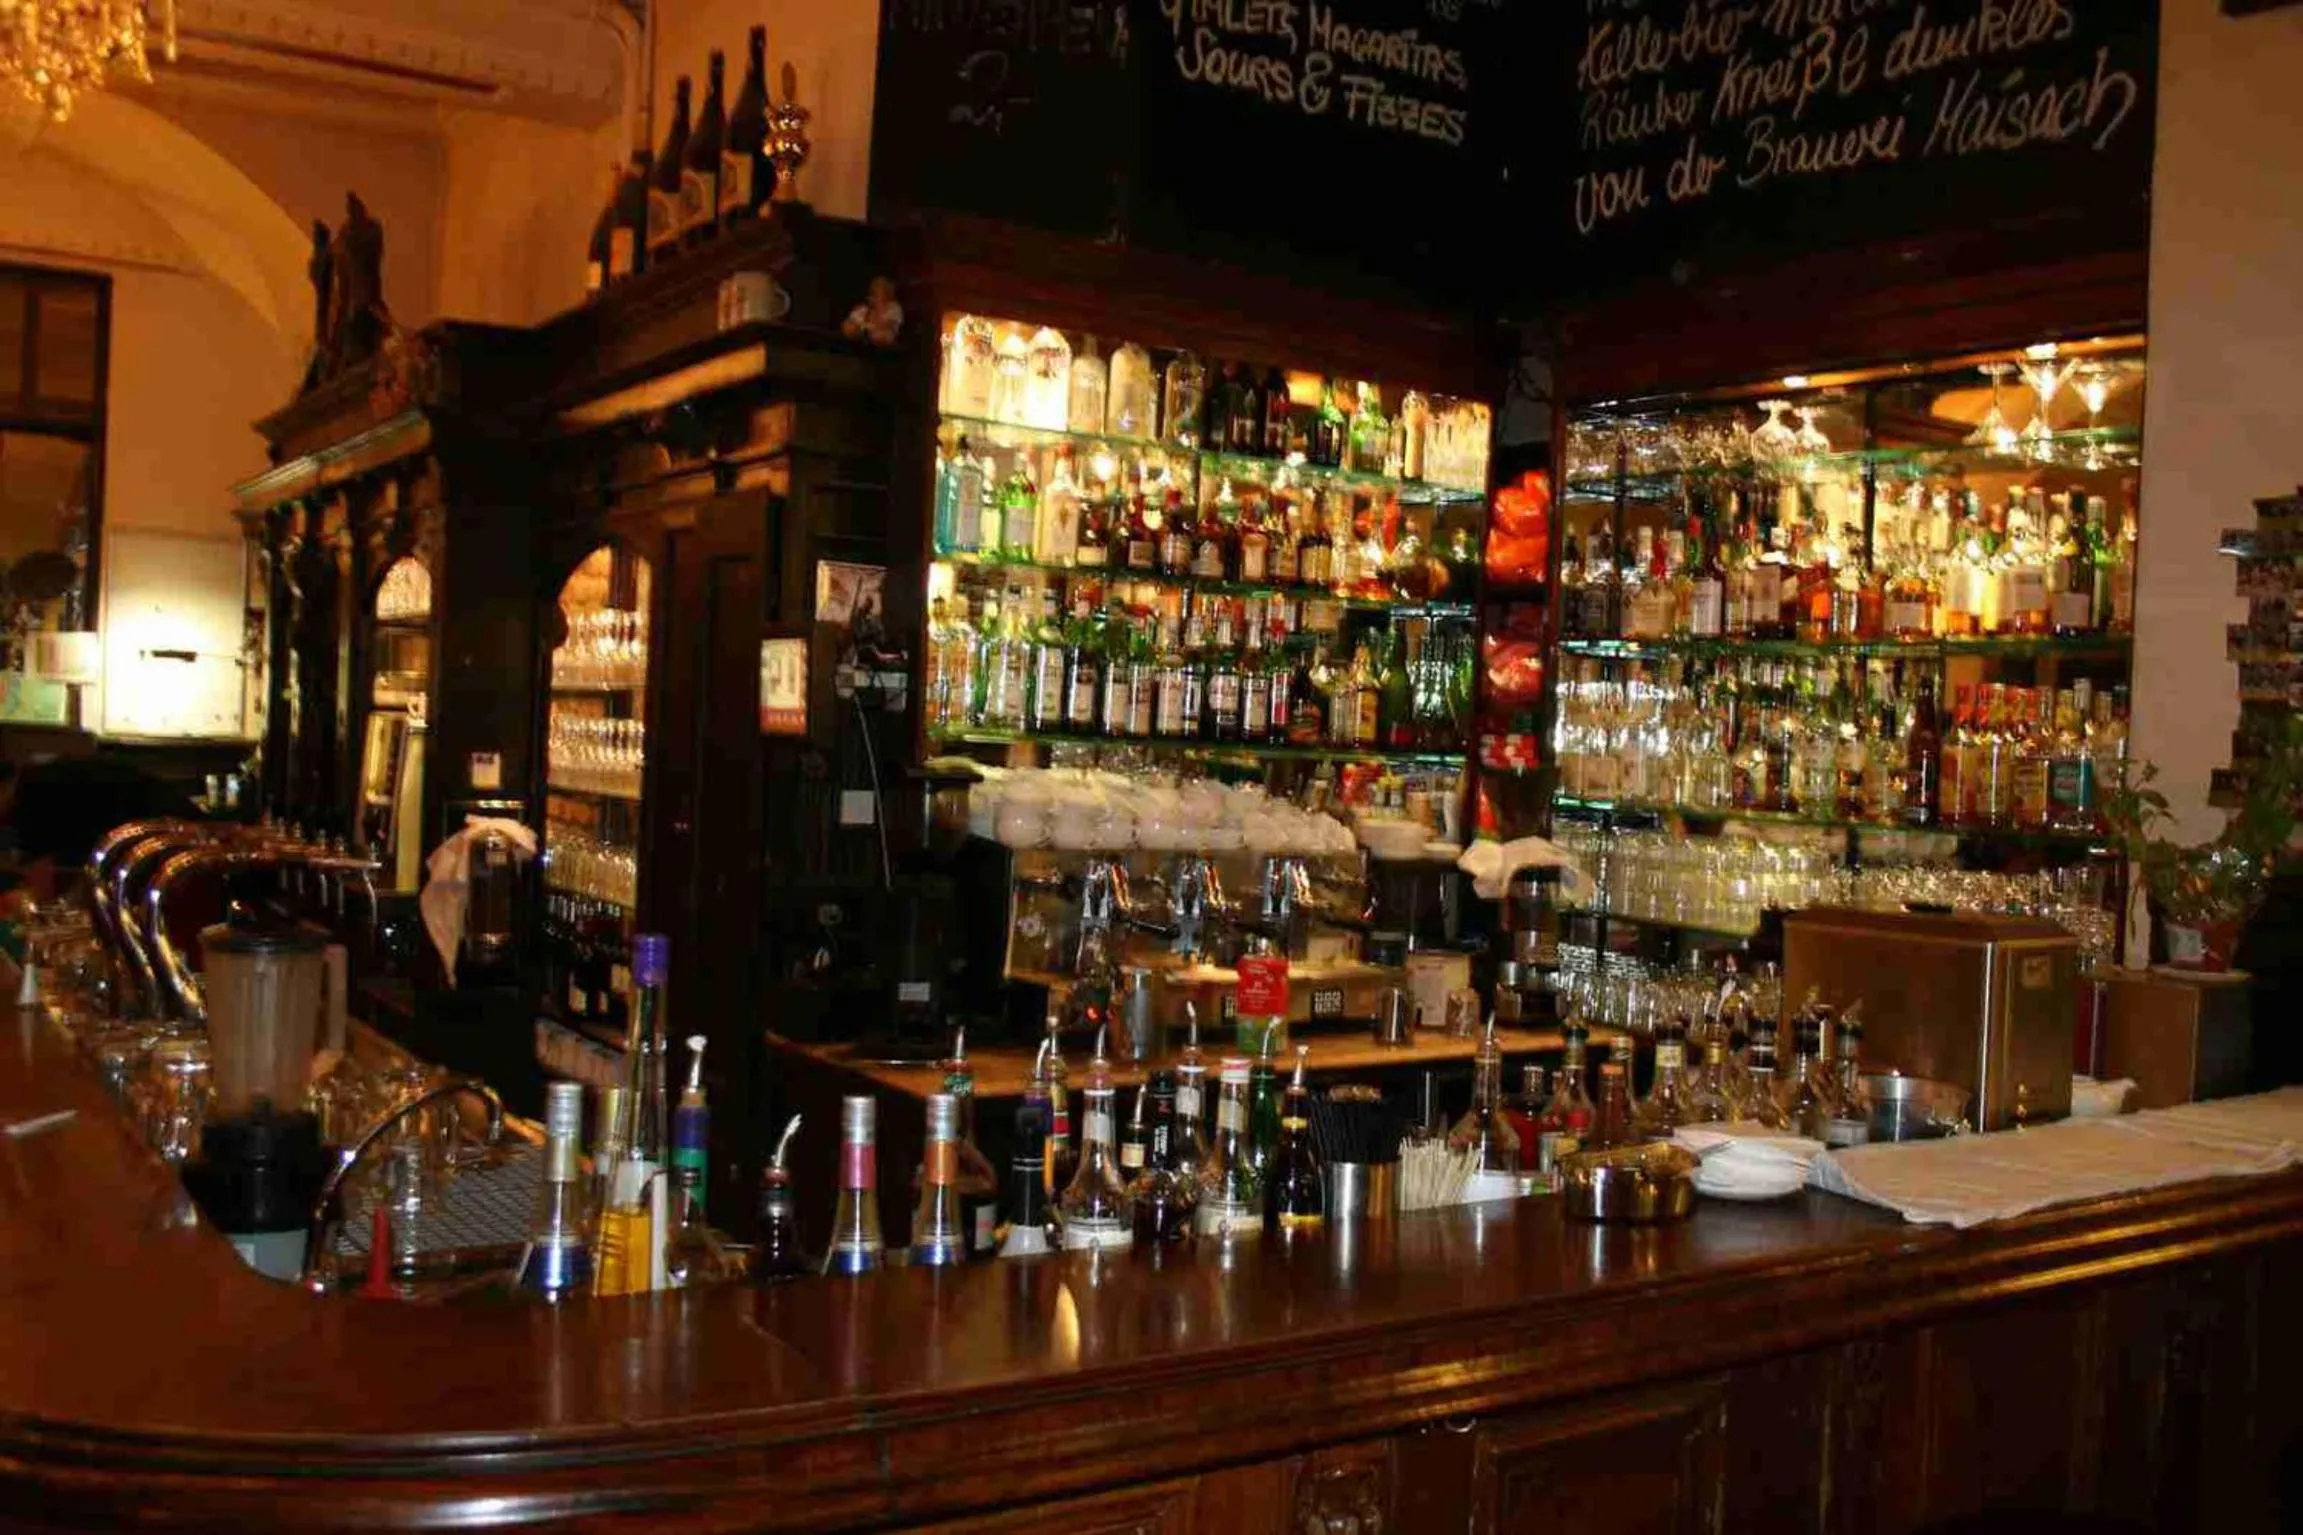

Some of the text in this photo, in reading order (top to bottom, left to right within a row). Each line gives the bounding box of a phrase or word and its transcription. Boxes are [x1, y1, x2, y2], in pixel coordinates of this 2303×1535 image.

[1299, 50, 1335, 116] &
[1580, 79, 1703, 152] Räuber
[1665, 133, 1727, 203] der
[1736, 91, 1913, 190] Brauerei
